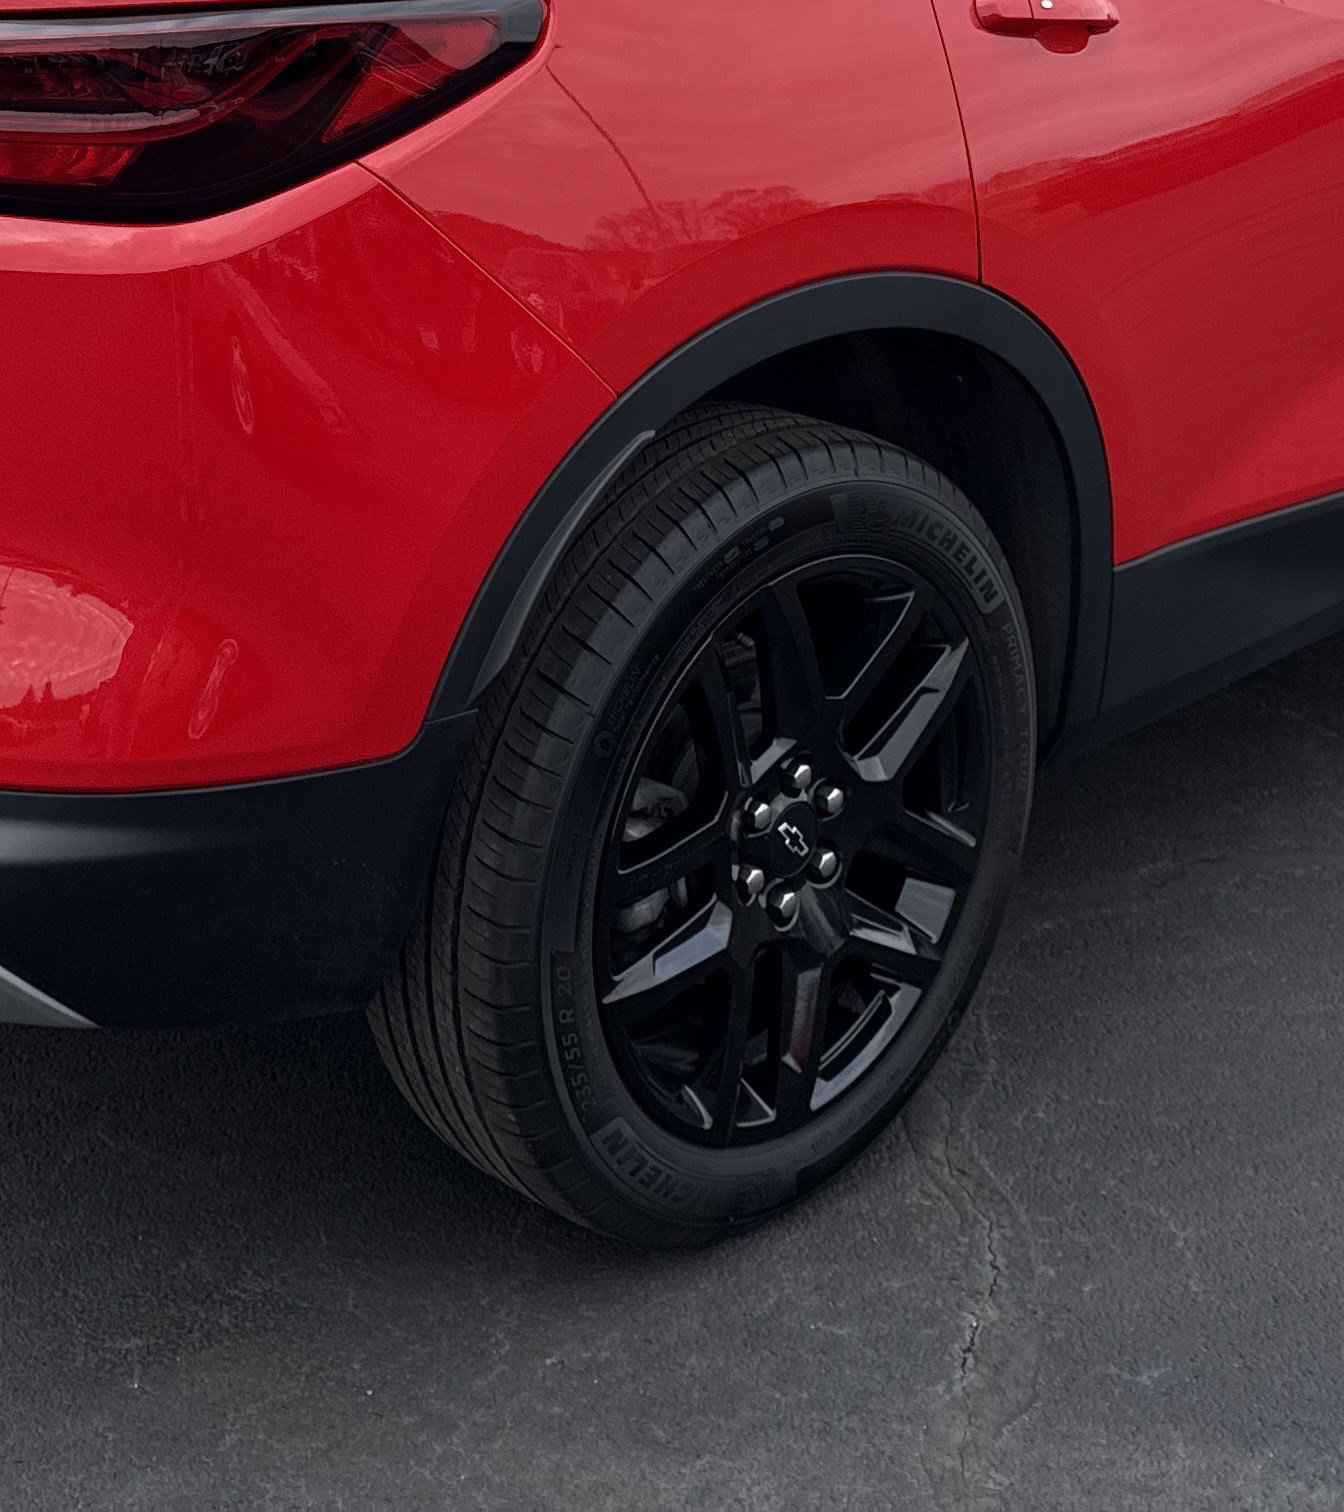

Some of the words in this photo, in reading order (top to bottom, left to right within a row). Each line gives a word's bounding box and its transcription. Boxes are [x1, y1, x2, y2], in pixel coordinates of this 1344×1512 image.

[896, 508, 999, 604] MICHELIN
[1000, 621, 1028, 716] PRIMACY
[556, 965, 573, 997] 20
[559, 1008, 576, 1024] R
[561, 1033, 598, 1112] 235/55
